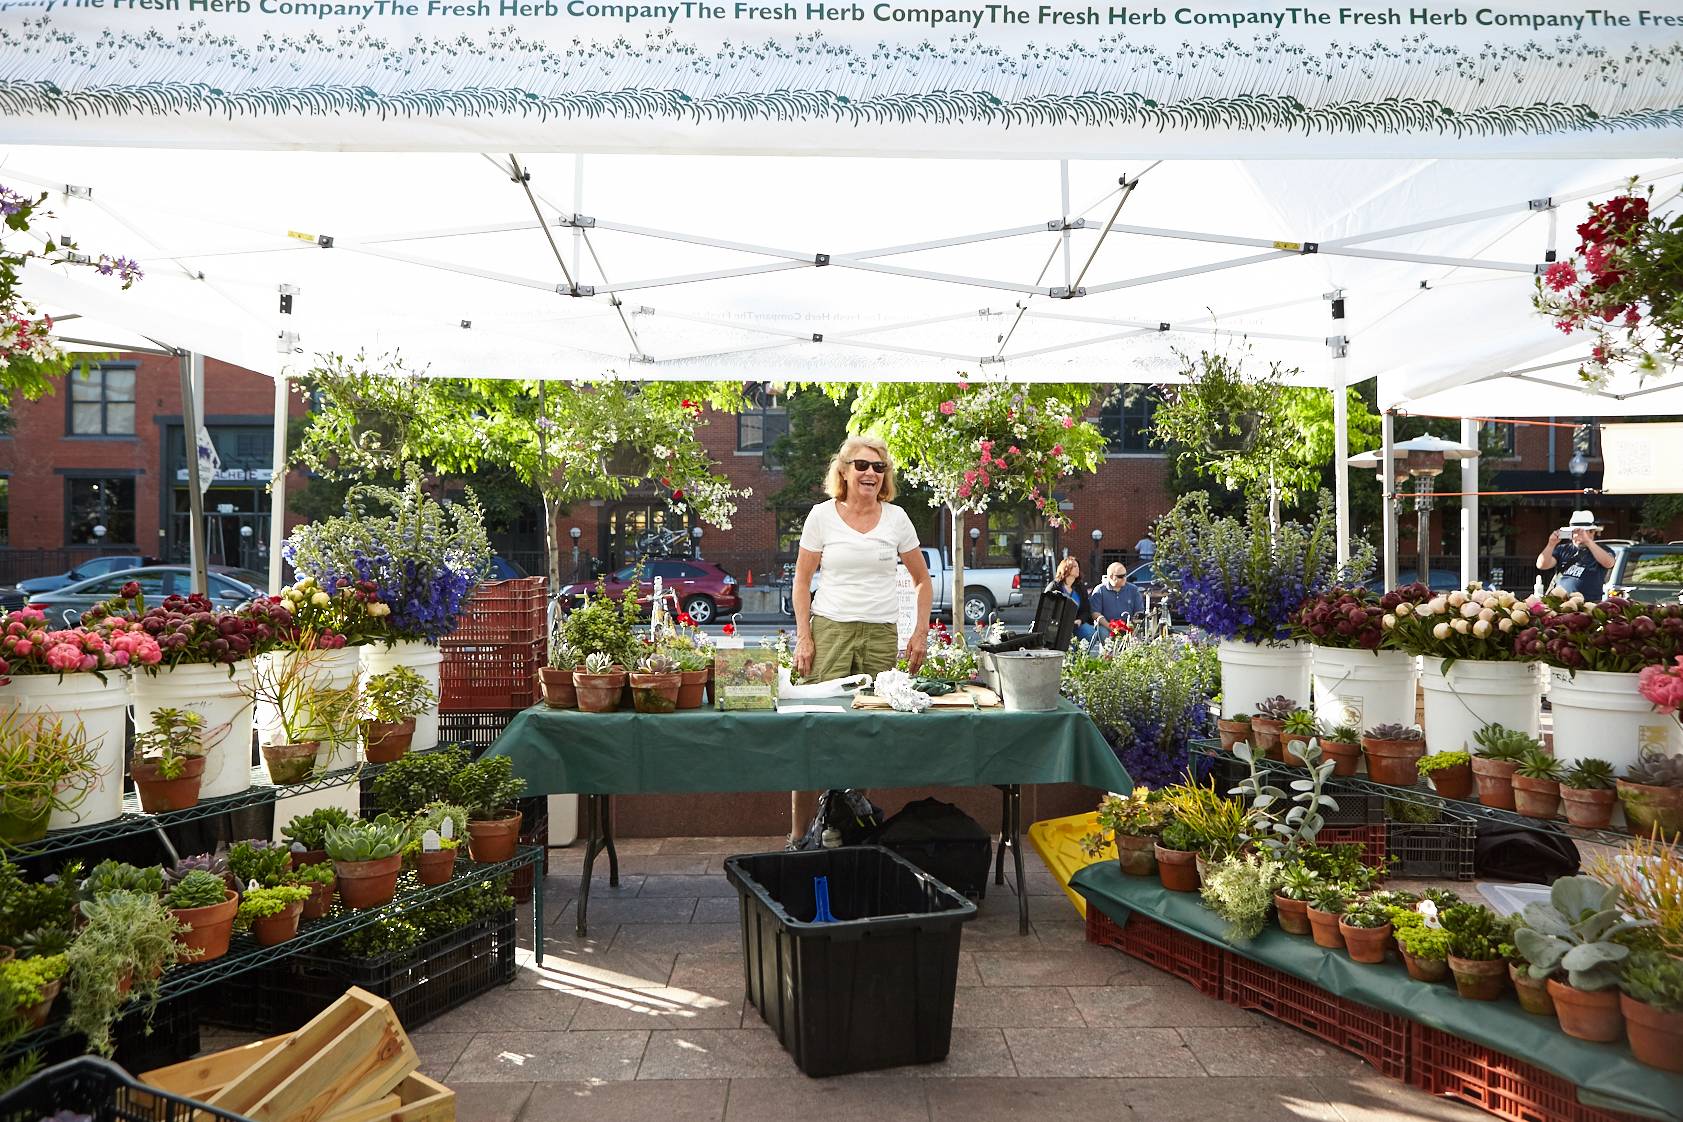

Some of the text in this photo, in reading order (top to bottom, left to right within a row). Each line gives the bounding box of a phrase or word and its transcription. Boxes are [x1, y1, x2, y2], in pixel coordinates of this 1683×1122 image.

[189, 0, 251, 13] Herb
[427, 0, 490, 17] Fresh
[499, 0, 559, 17] Herb
[734, 2, 797, 20] Fresh
[806, 3, 865, 21] Herb
[1038, 6, 1100, 25] Fresh
[1108, 7, 1167, 25] Herb
[1339, 8, 1401, 25] Fresh
[1409, 8, 1468, 26] Herb
[1638, 10, 1683, 27] Fres
